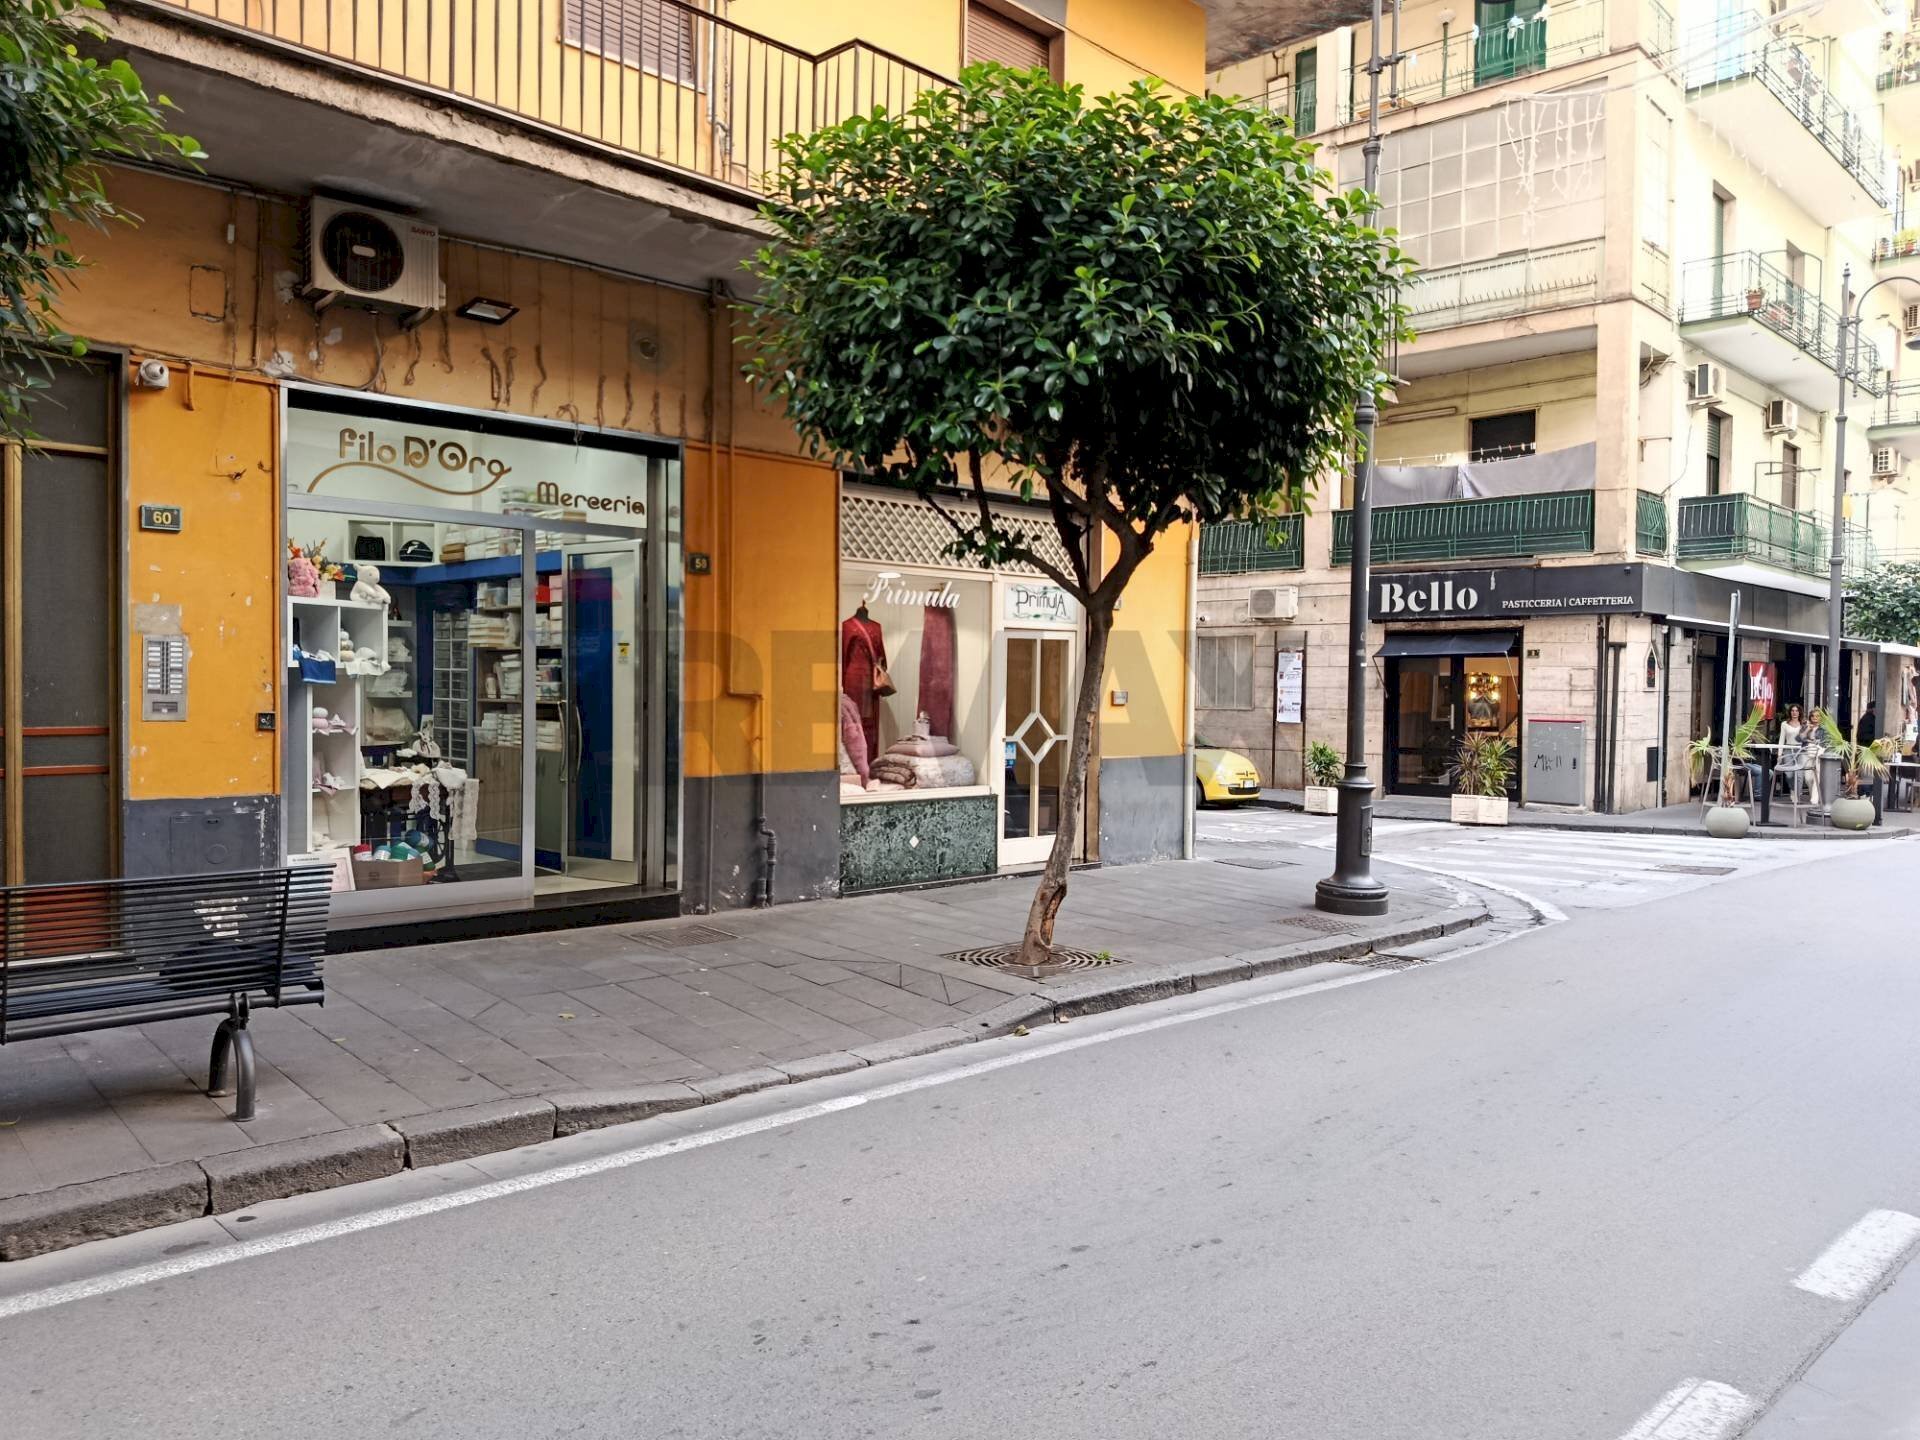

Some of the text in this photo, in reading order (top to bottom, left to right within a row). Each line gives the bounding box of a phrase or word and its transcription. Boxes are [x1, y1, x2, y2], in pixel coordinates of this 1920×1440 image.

[537, 481, 645, 516] Merceria
[153, 511, 172, 525] 60
[863, 574, 961, 609] Primula
[1379, 580, 1479, 613] Bello
[1501, 595, 1635, 609] PASTICCERIA CAFFETTERIA
